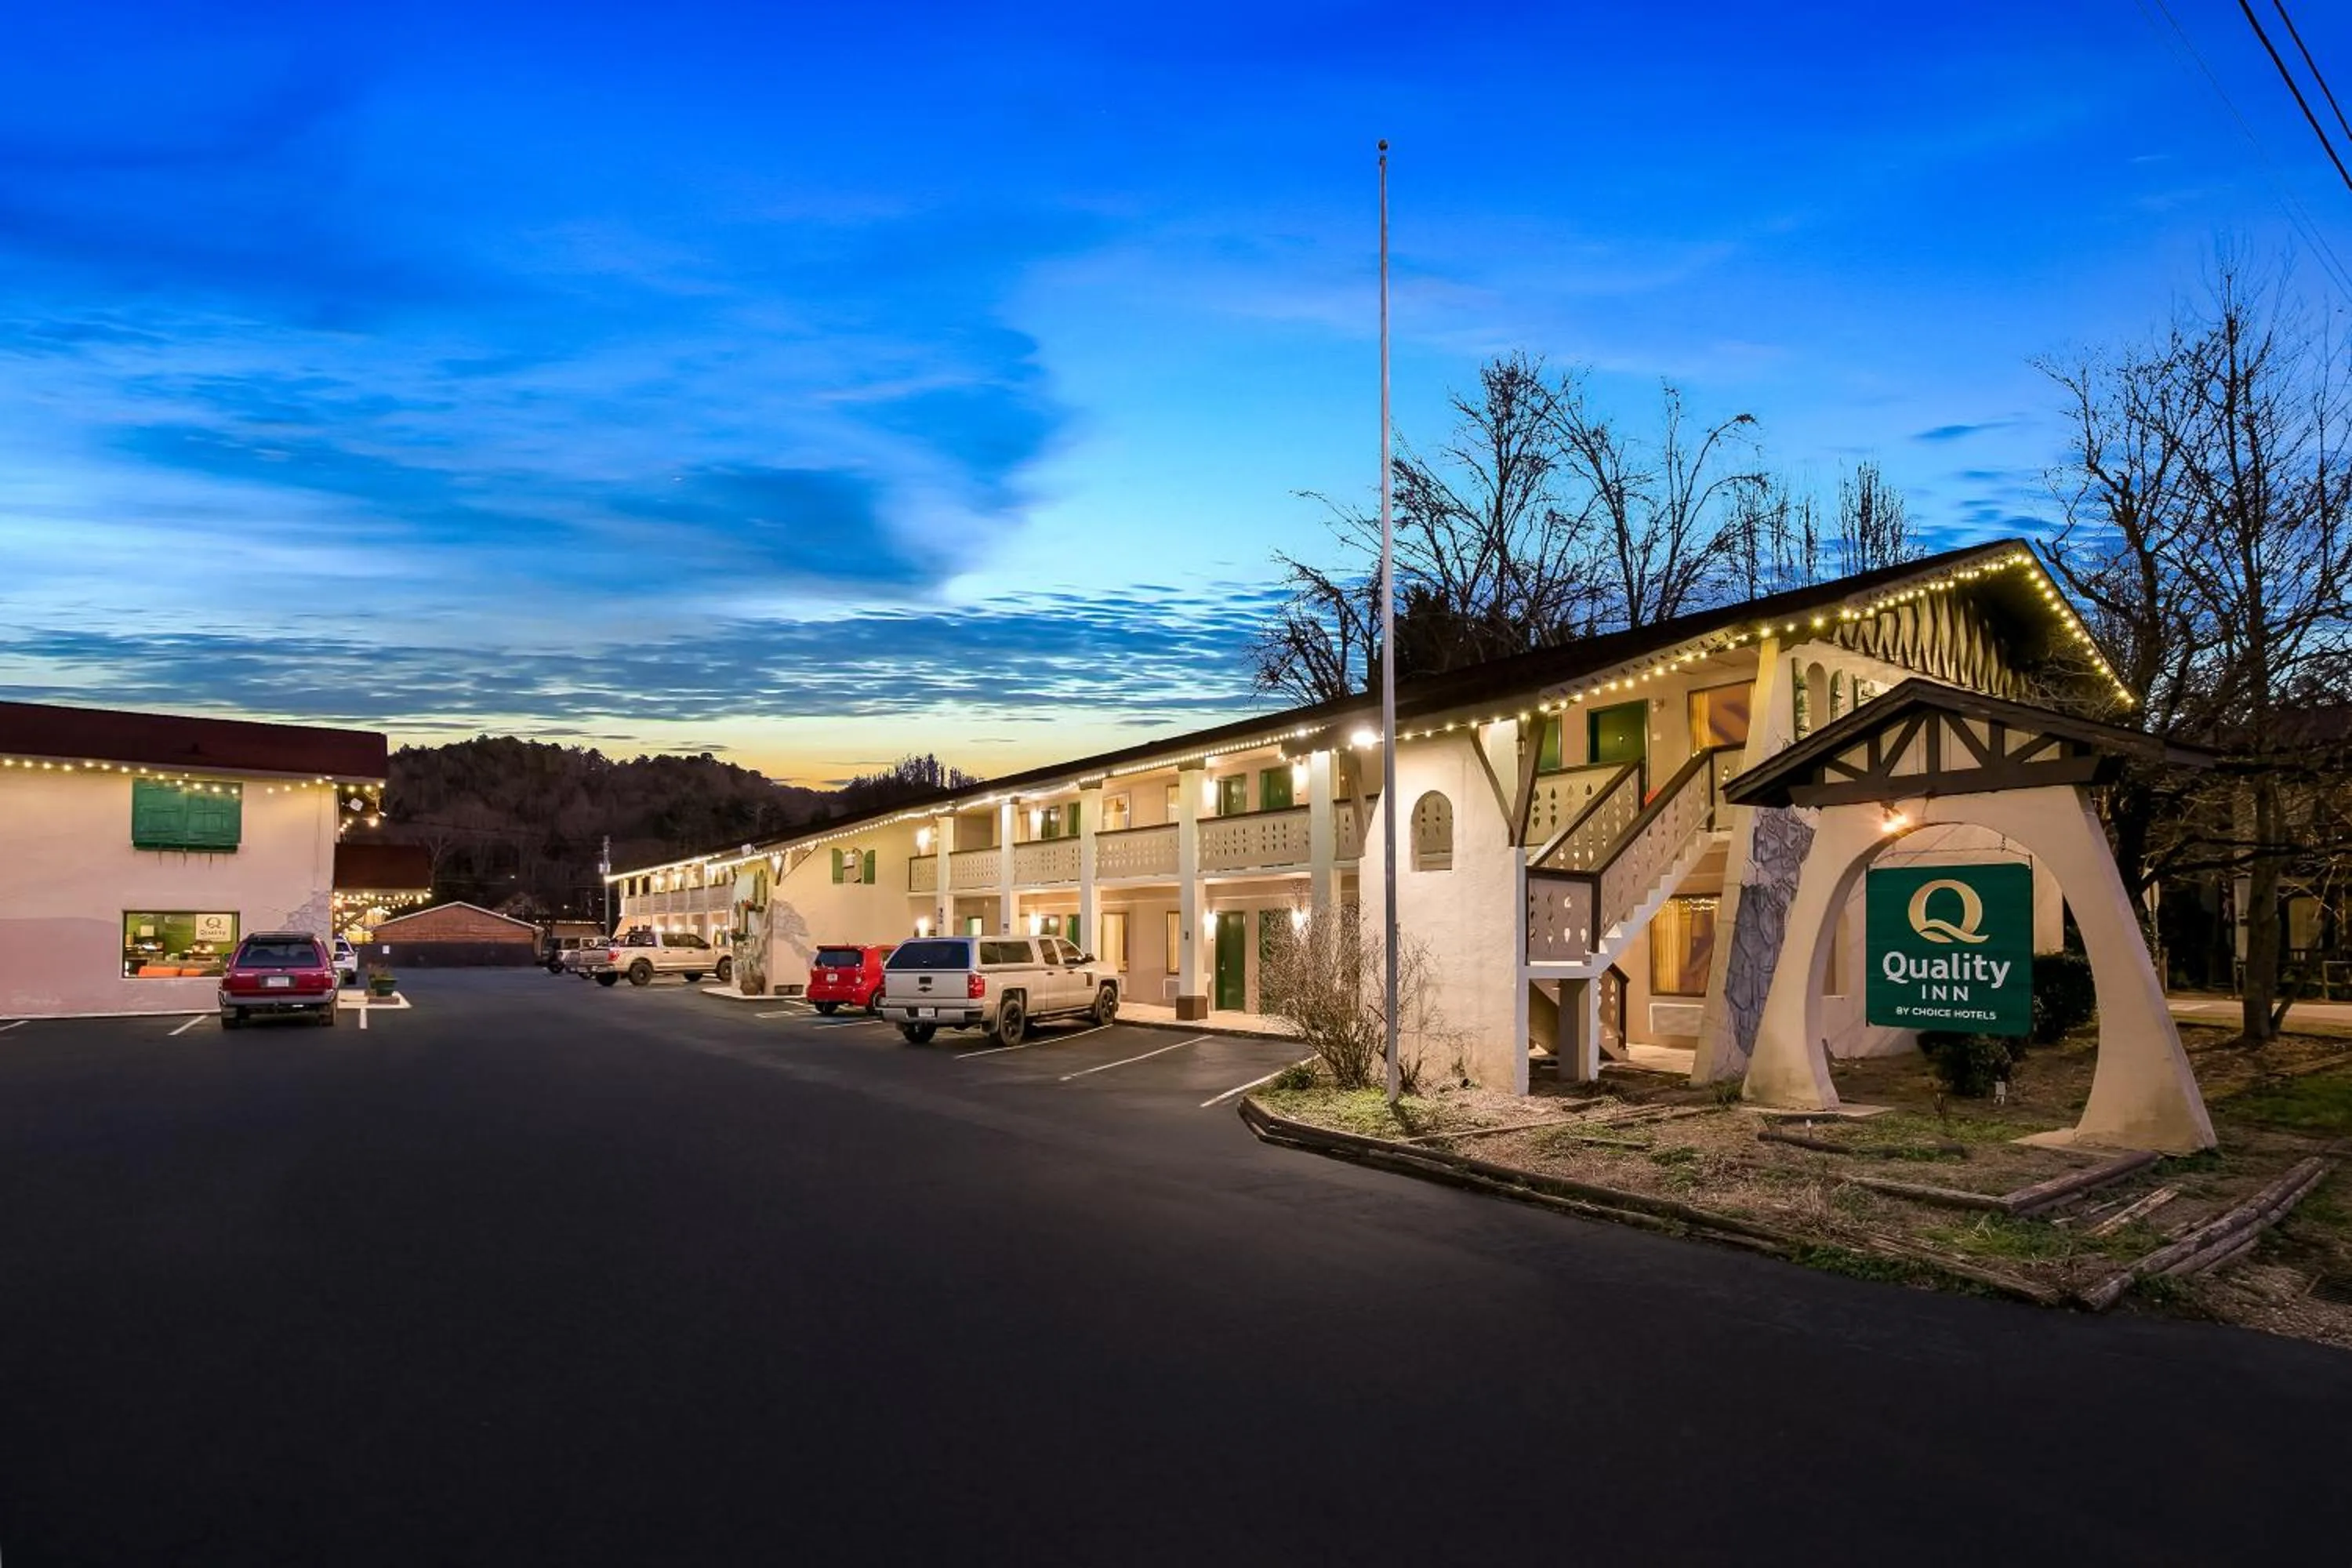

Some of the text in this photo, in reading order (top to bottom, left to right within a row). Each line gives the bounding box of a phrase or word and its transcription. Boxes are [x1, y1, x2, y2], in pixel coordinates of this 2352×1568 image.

[1907, 879, 1990, 943] Q
[1882, 951, 2011, 989] Quality
[1922, 984, 1969, 1002] INN
[1896, 1006, 1997, 1020] BY CHOICE HOTELS
